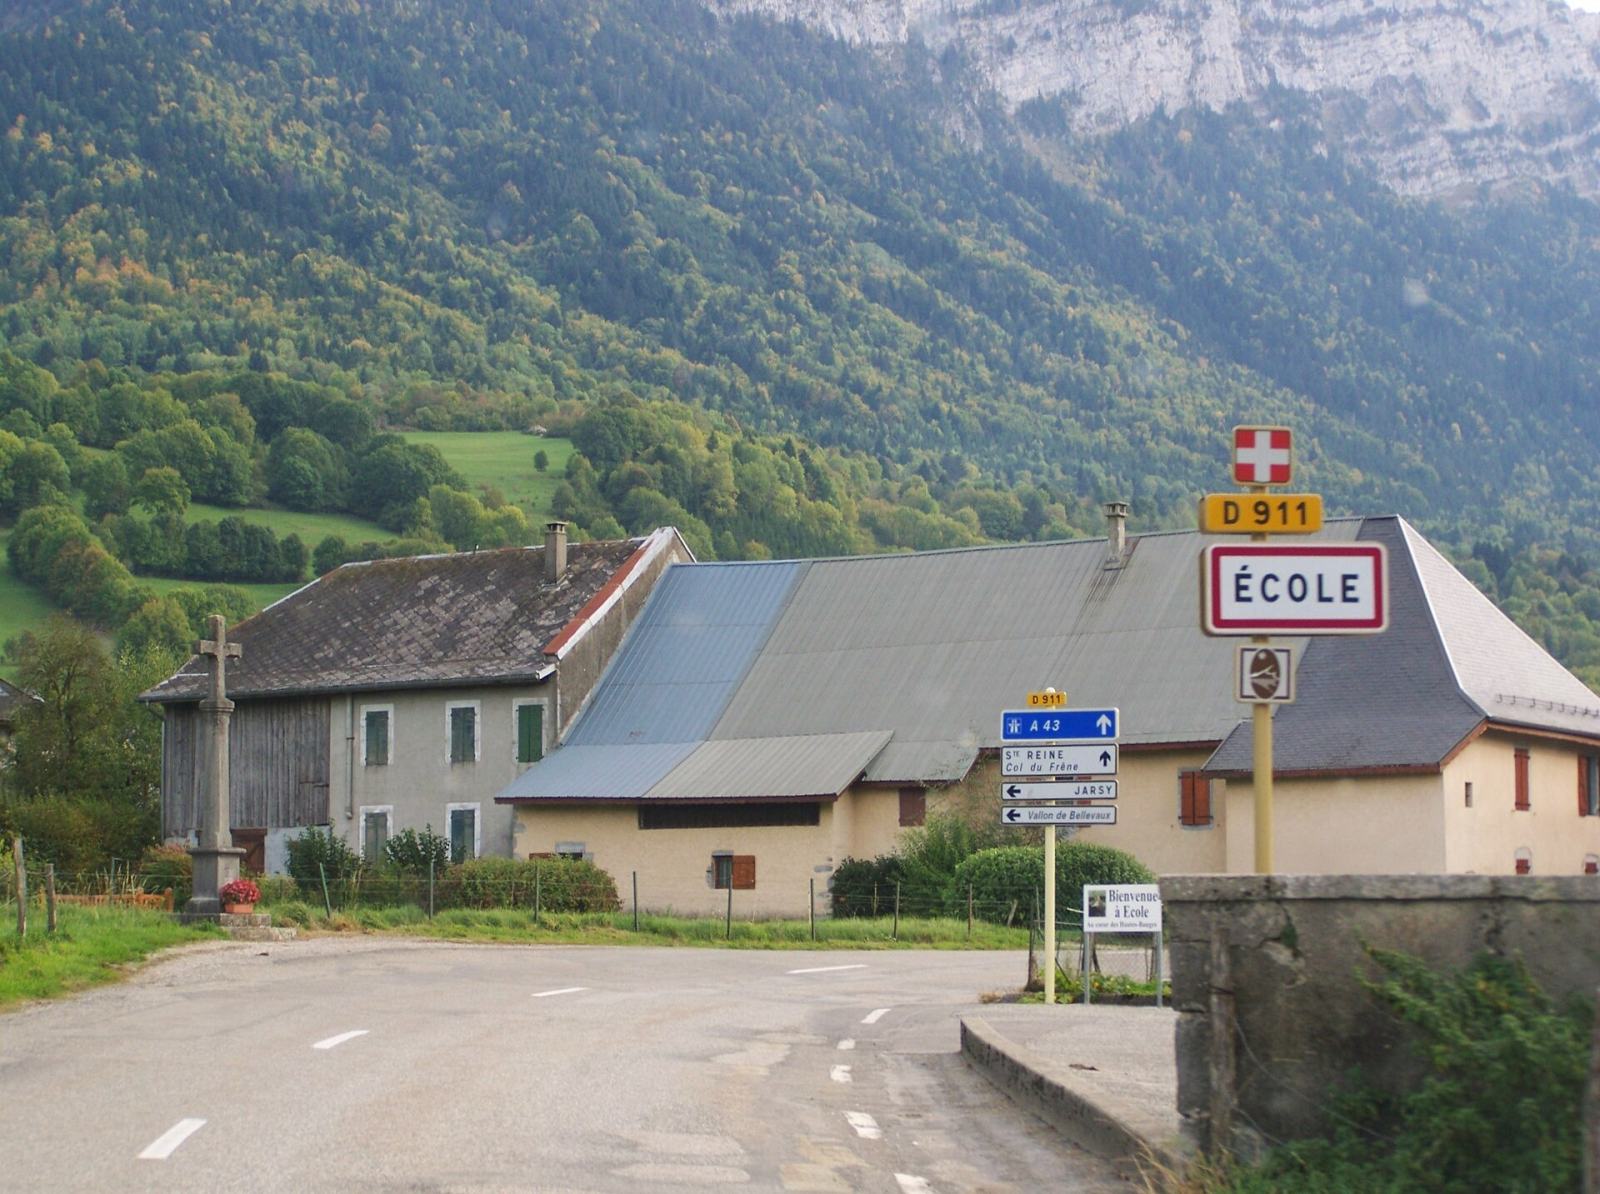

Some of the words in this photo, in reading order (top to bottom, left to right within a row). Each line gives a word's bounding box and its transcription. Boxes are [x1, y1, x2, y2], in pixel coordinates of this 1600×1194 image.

[1224, 501, 1240, 525] D
[1254, 501, 1308, 525] 911
[1234, 565, 1360, 603] ÉCOLE
[1032, 695, 1039, 704] D
[1042, 694, 1061, 704] 911
[1030, 721, 1039, 732] A
[1043, 720, 1060, 731] 43
[1027, 750, 1064, 760] REINE
[1006, 763, 1023, 772] Col
[1031, 763, 1042, 772] du
[1074, 785, 1113, 795] JARSY
[1028, 811, 1055, 820] Vallon
[1056, 811, 1067, 819] de
[1069, 810, 1112, 820] Bellevaux
[1109, 890, 1158, 902] Bienvenue
[1115, 905, 1121, 918] à
[1123, 905, 1149, 918] Ecole
